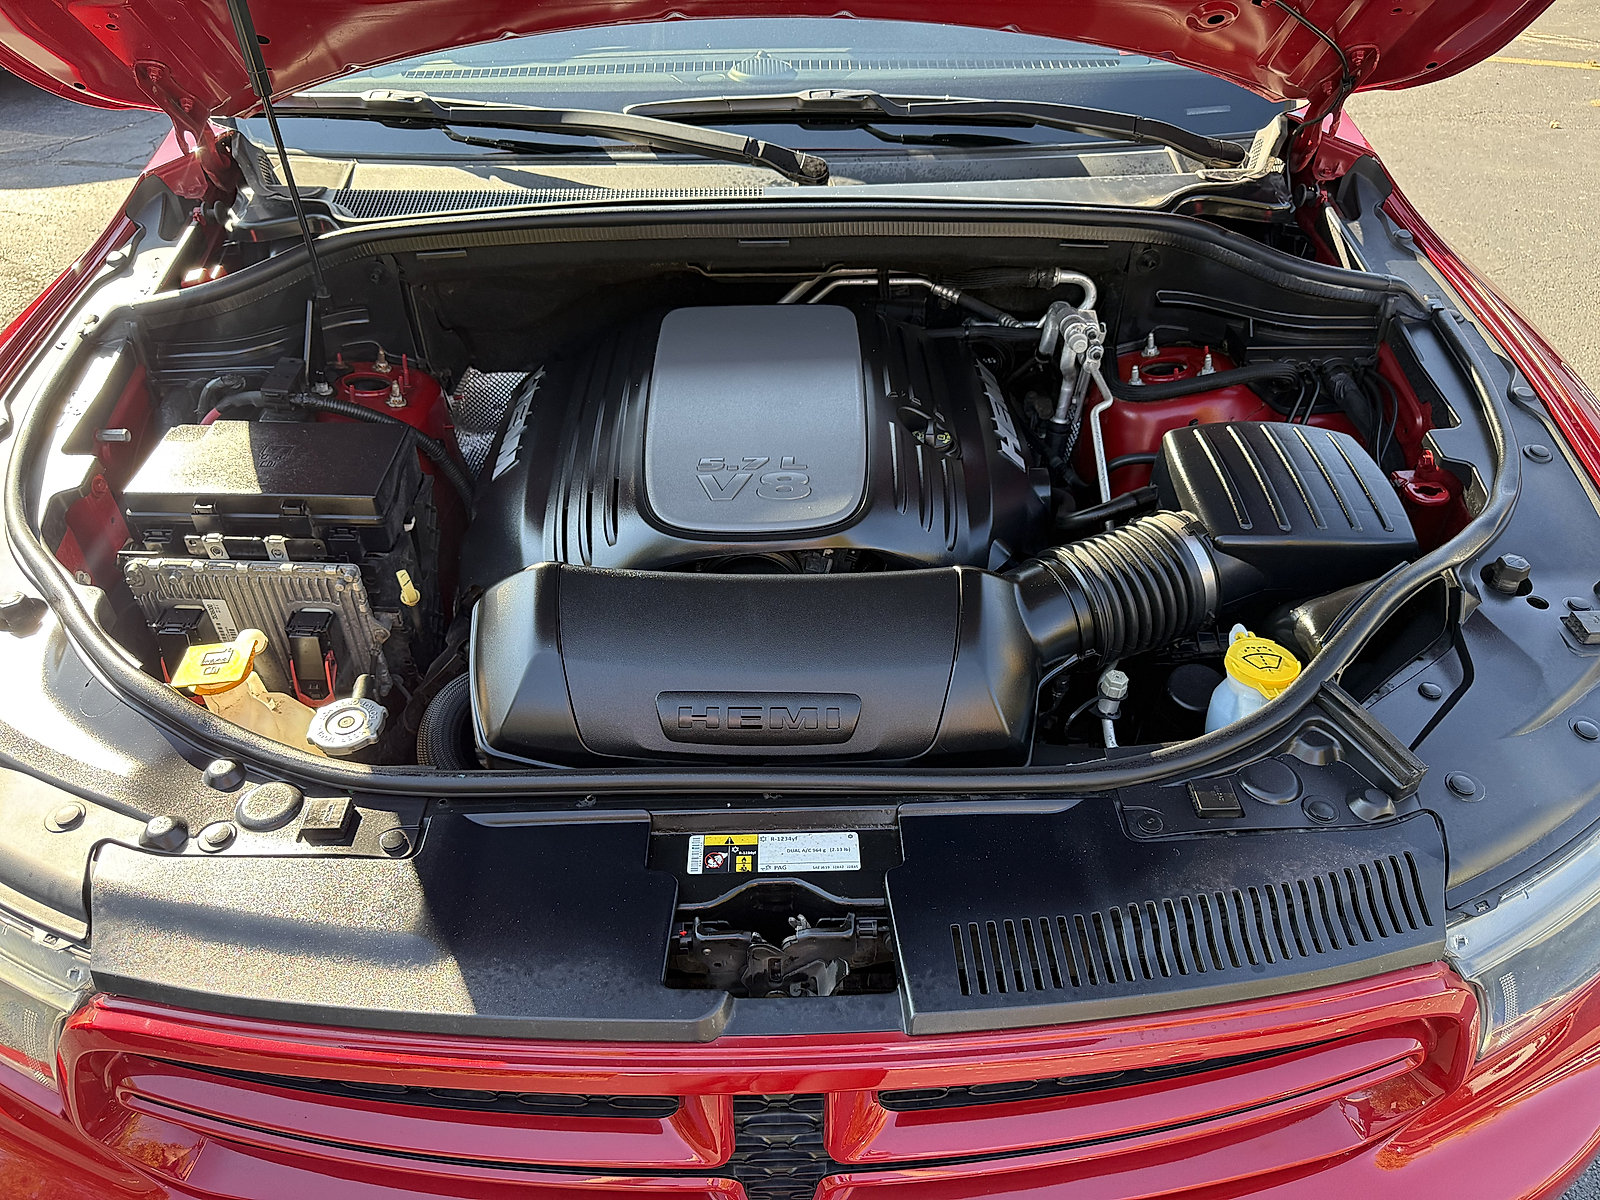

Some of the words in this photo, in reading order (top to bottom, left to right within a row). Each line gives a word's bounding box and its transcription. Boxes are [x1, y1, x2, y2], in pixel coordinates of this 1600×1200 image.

[696, 456, 770, 472] 5.7
[780, 456, 808, 471] L
[696, 471, 812, 501] V8
[677, 706, 842, 730] HEMI
